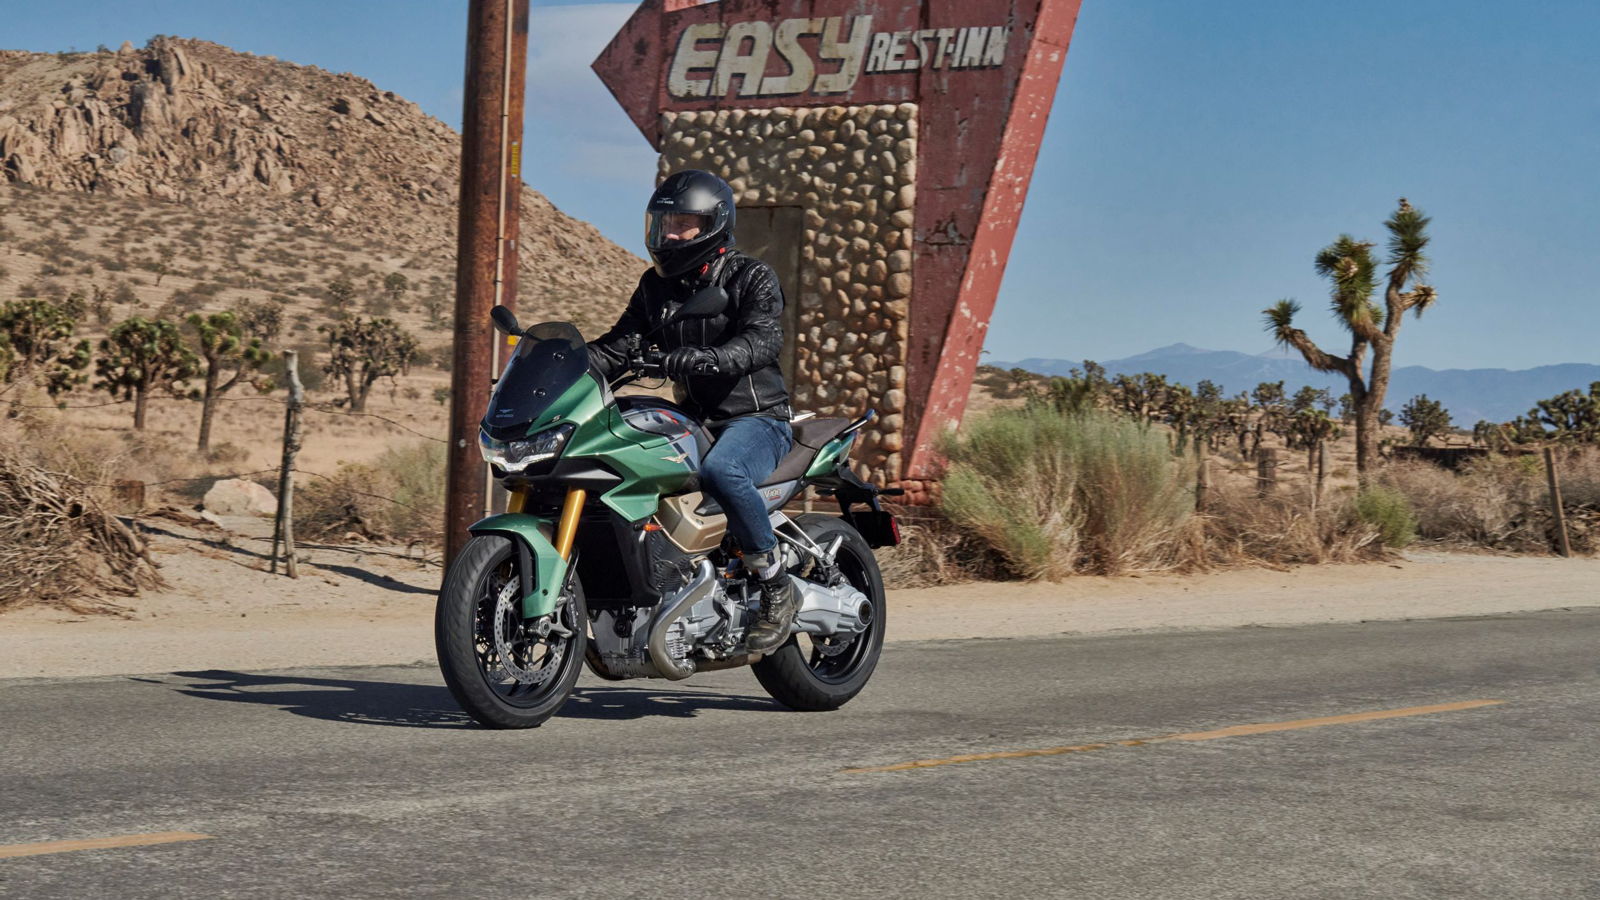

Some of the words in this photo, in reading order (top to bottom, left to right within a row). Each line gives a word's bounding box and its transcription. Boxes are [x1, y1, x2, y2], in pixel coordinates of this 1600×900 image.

[667, 15, 873, 99] EASY
[865, 26, 1008, 73] REST-INN
[763, 488, 782, 498] V100
